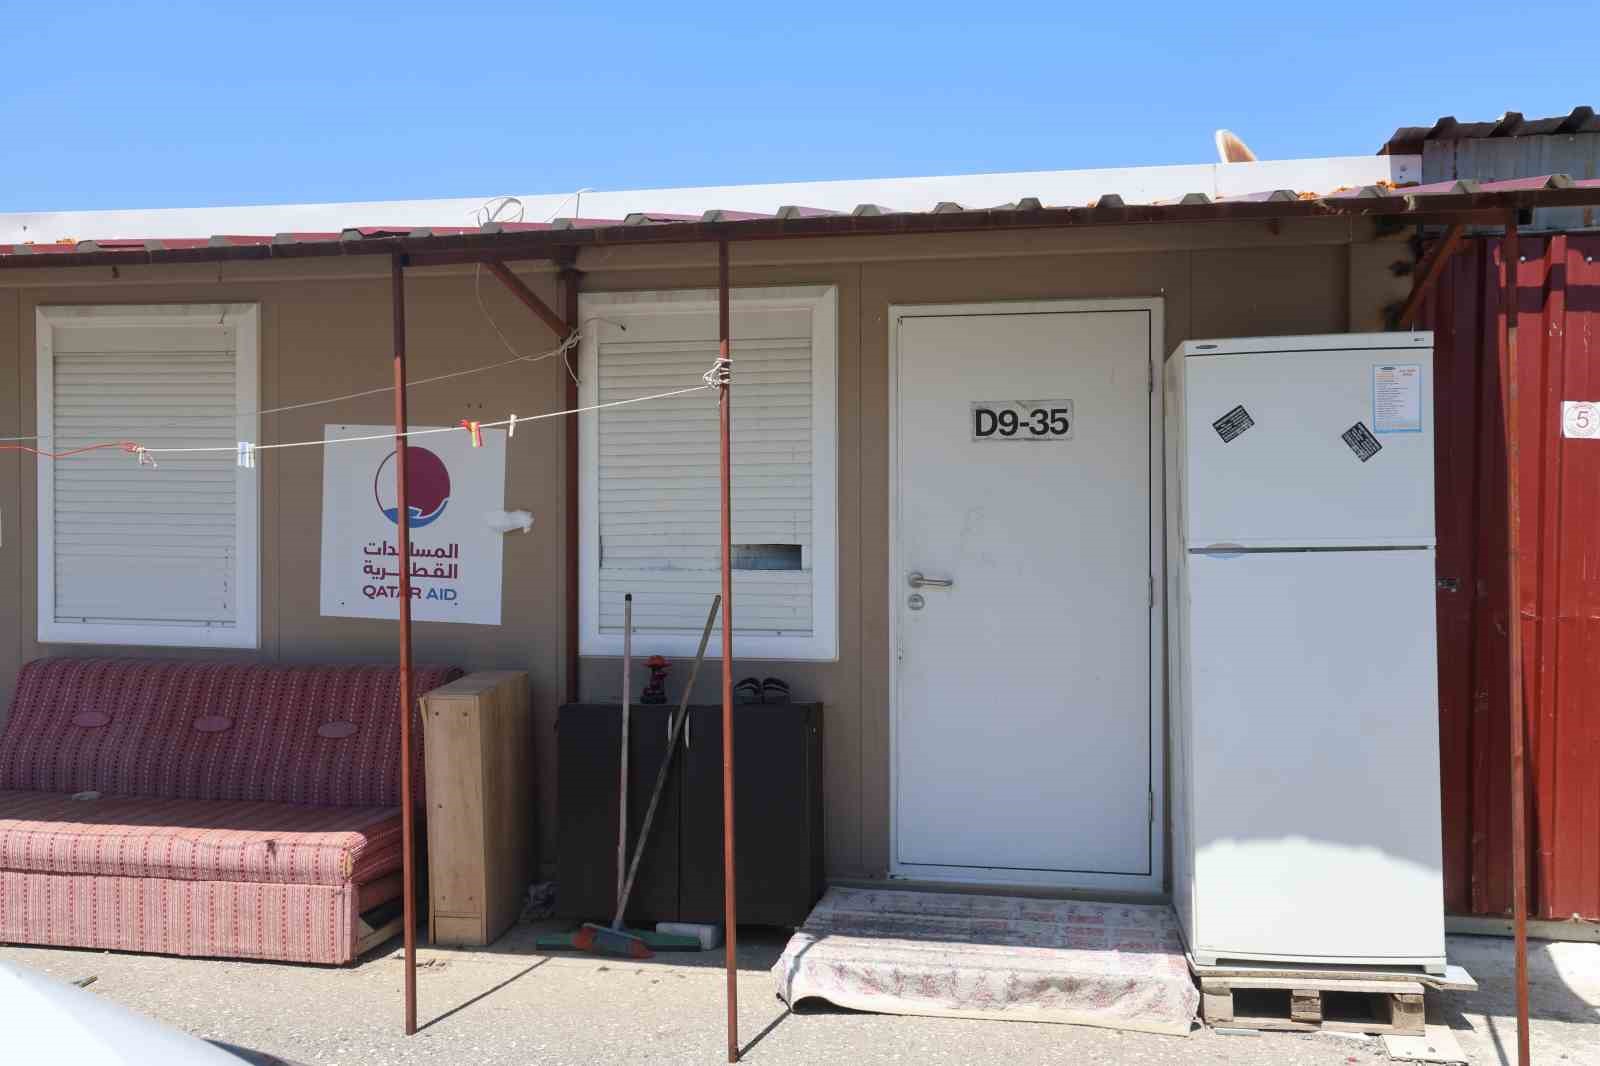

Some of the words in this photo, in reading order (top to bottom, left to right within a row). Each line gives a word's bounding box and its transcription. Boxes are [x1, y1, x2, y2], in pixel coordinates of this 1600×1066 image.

[975, 408, 1069, 436] D9-35
[1576, 411, 1589, 429] 5
[364, 541, 459, 559] المسادات
[362, 584, 422, 600] QATR
[426, 588, 457, 601] AID
